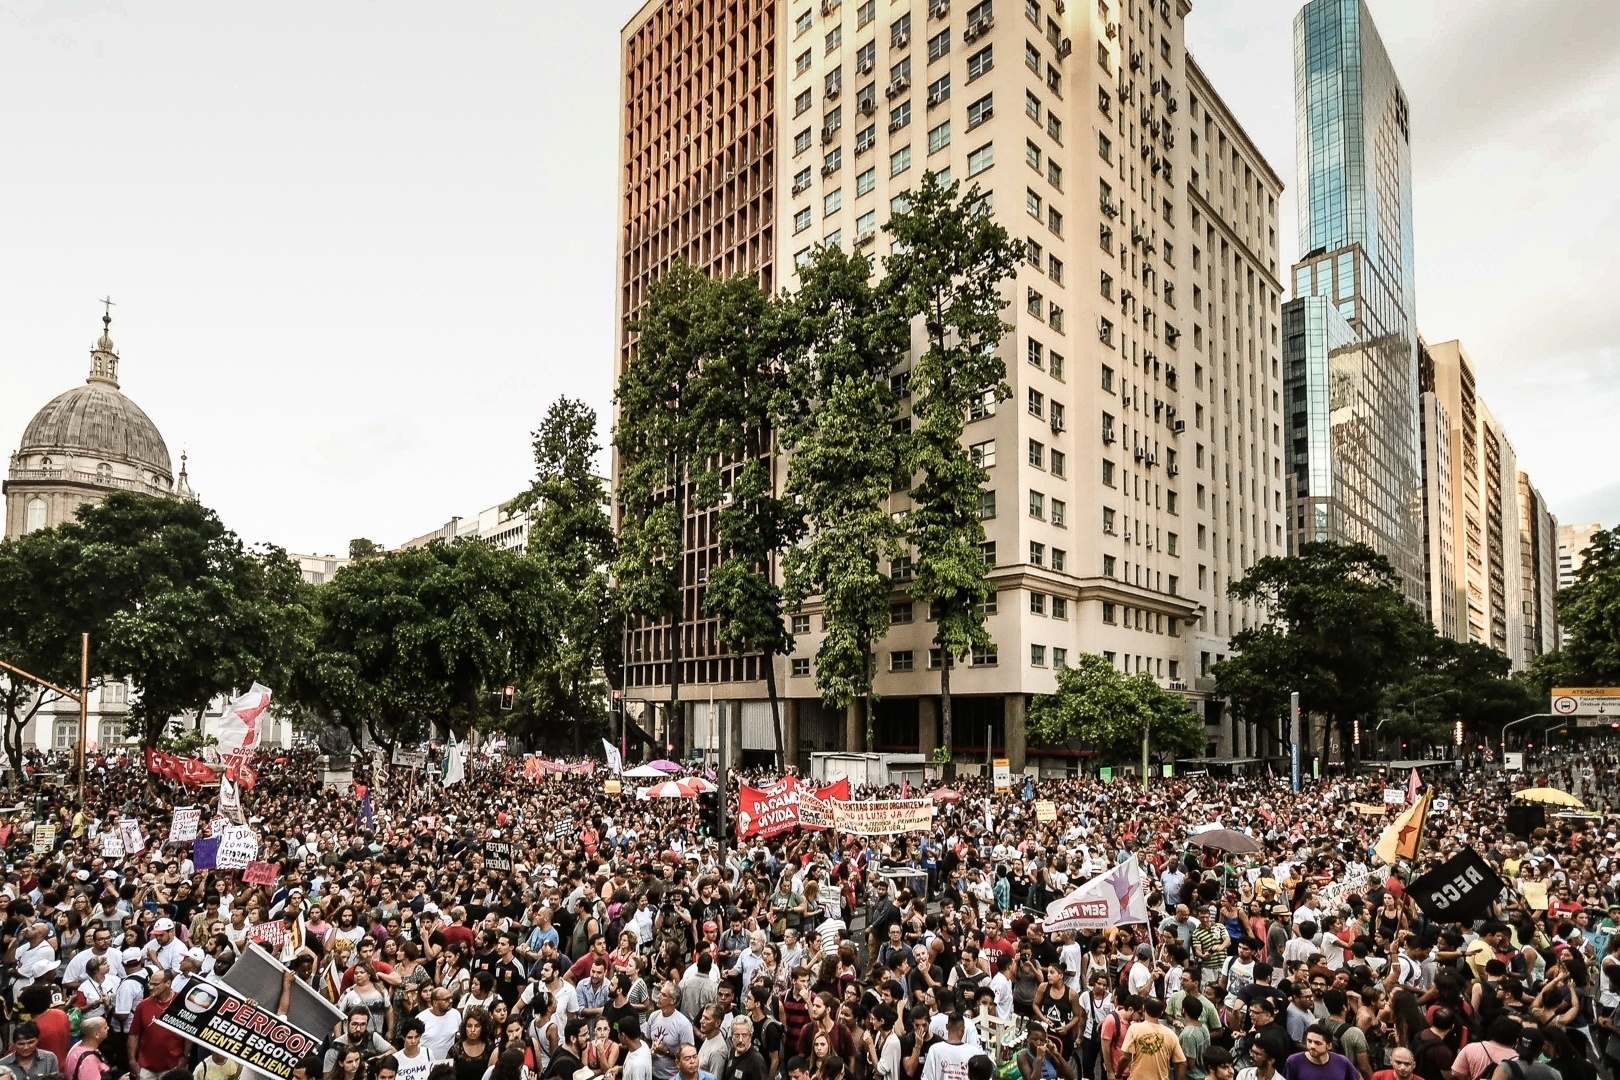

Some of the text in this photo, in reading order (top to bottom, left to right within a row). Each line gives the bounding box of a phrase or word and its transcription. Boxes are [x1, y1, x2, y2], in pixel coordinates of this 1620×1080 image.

[221, 849, 250, 860] REFORMA
[225, 842, 254, 850] CONTRA
[486, 841, 509, 854] REFORMA
[162, 1013, 199, 1036] GLOBOGOLPISTA
[217, 996, 314, 1059] PERIGO!
[199, 1028, 292, 1078] MENTE E ALIENA
[208, 1015, 299, 1068] REDE ESGOTO
